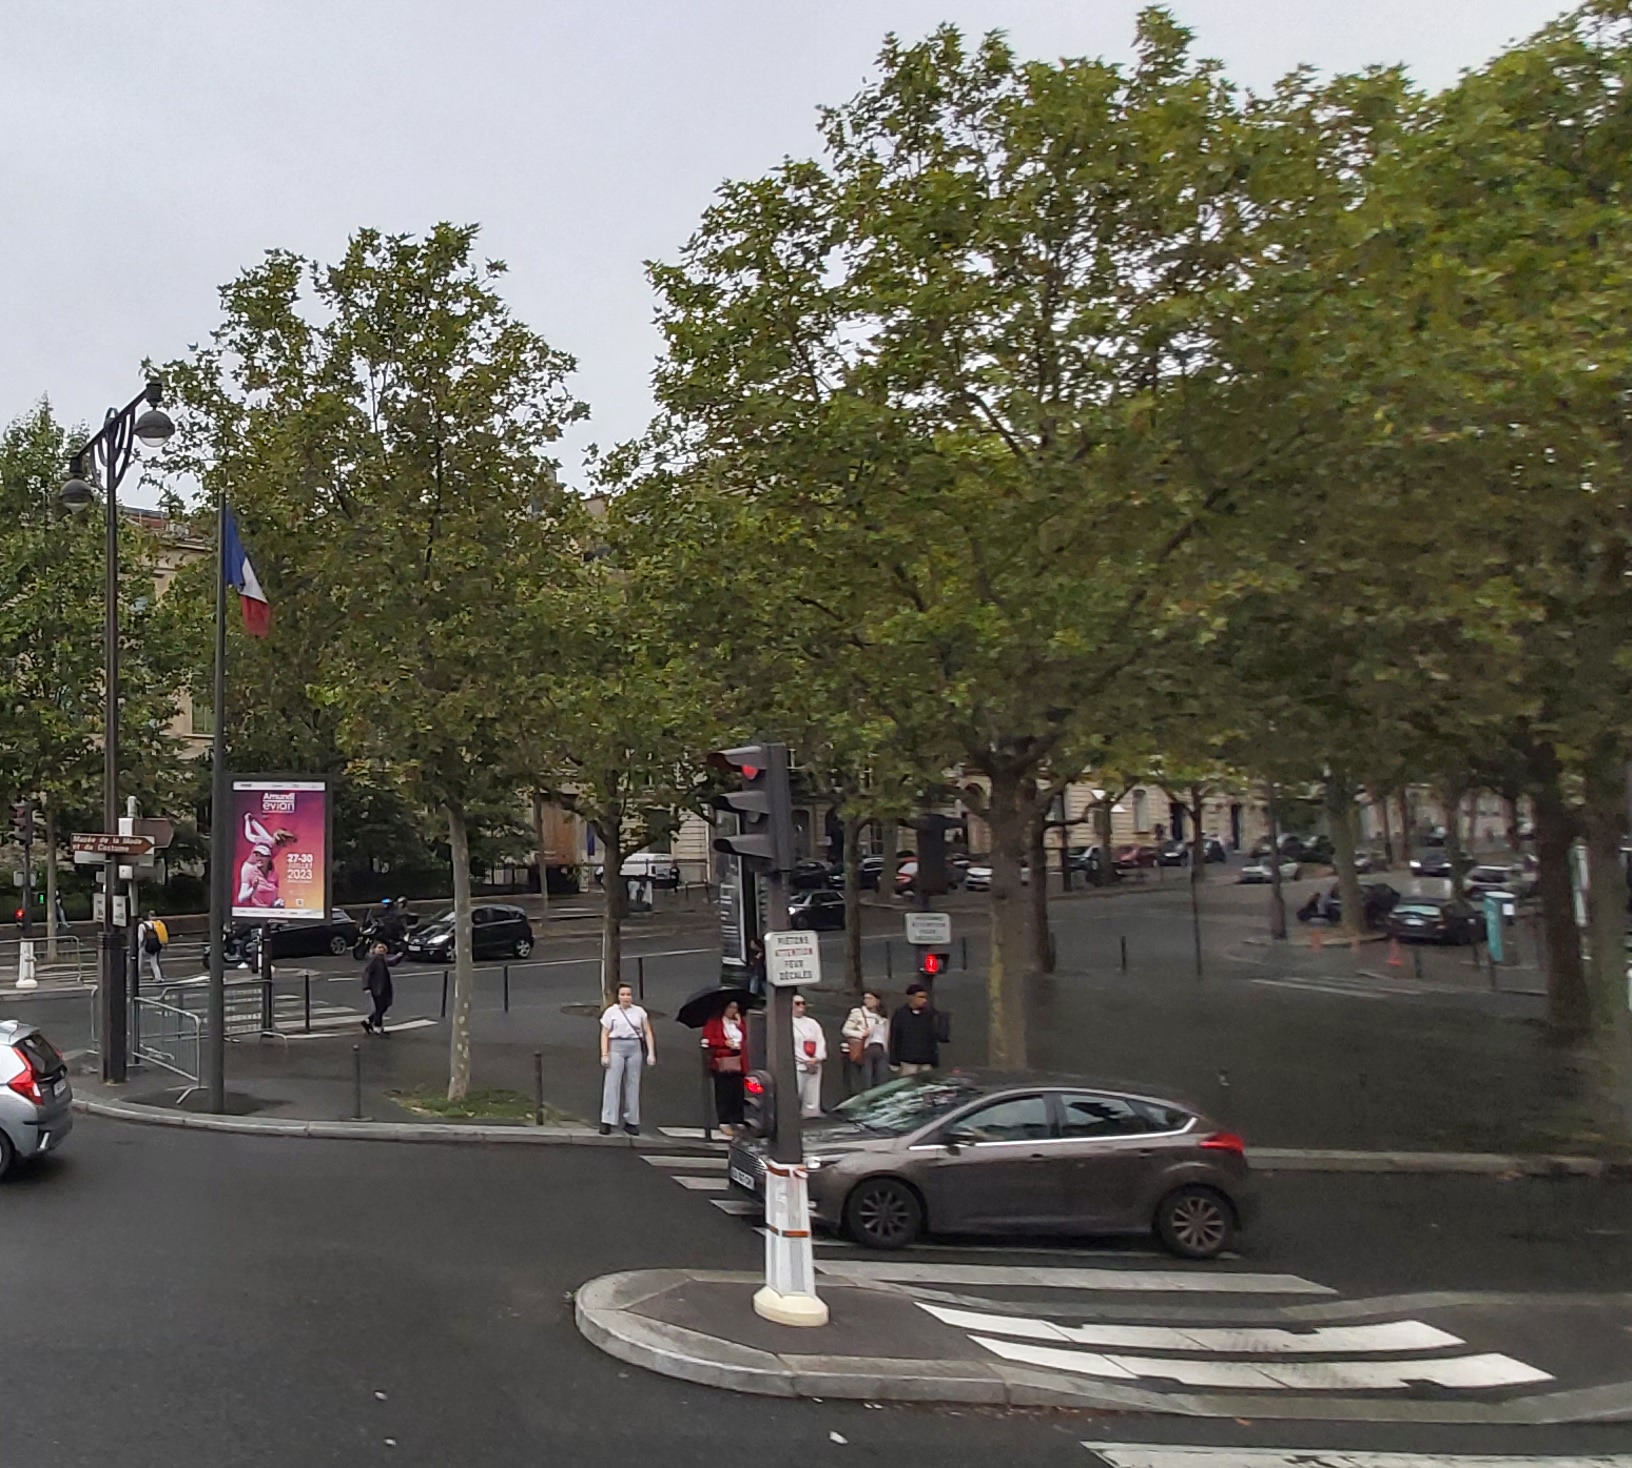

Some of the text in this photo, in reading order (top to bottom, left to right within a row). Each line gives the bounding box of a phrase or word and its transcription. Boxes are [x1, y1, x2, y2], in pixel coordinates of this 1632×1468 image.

[262, 802, 296, 811] evian
[99, 836, 110, 844] de
[287, 869, 313, 880] 2023
